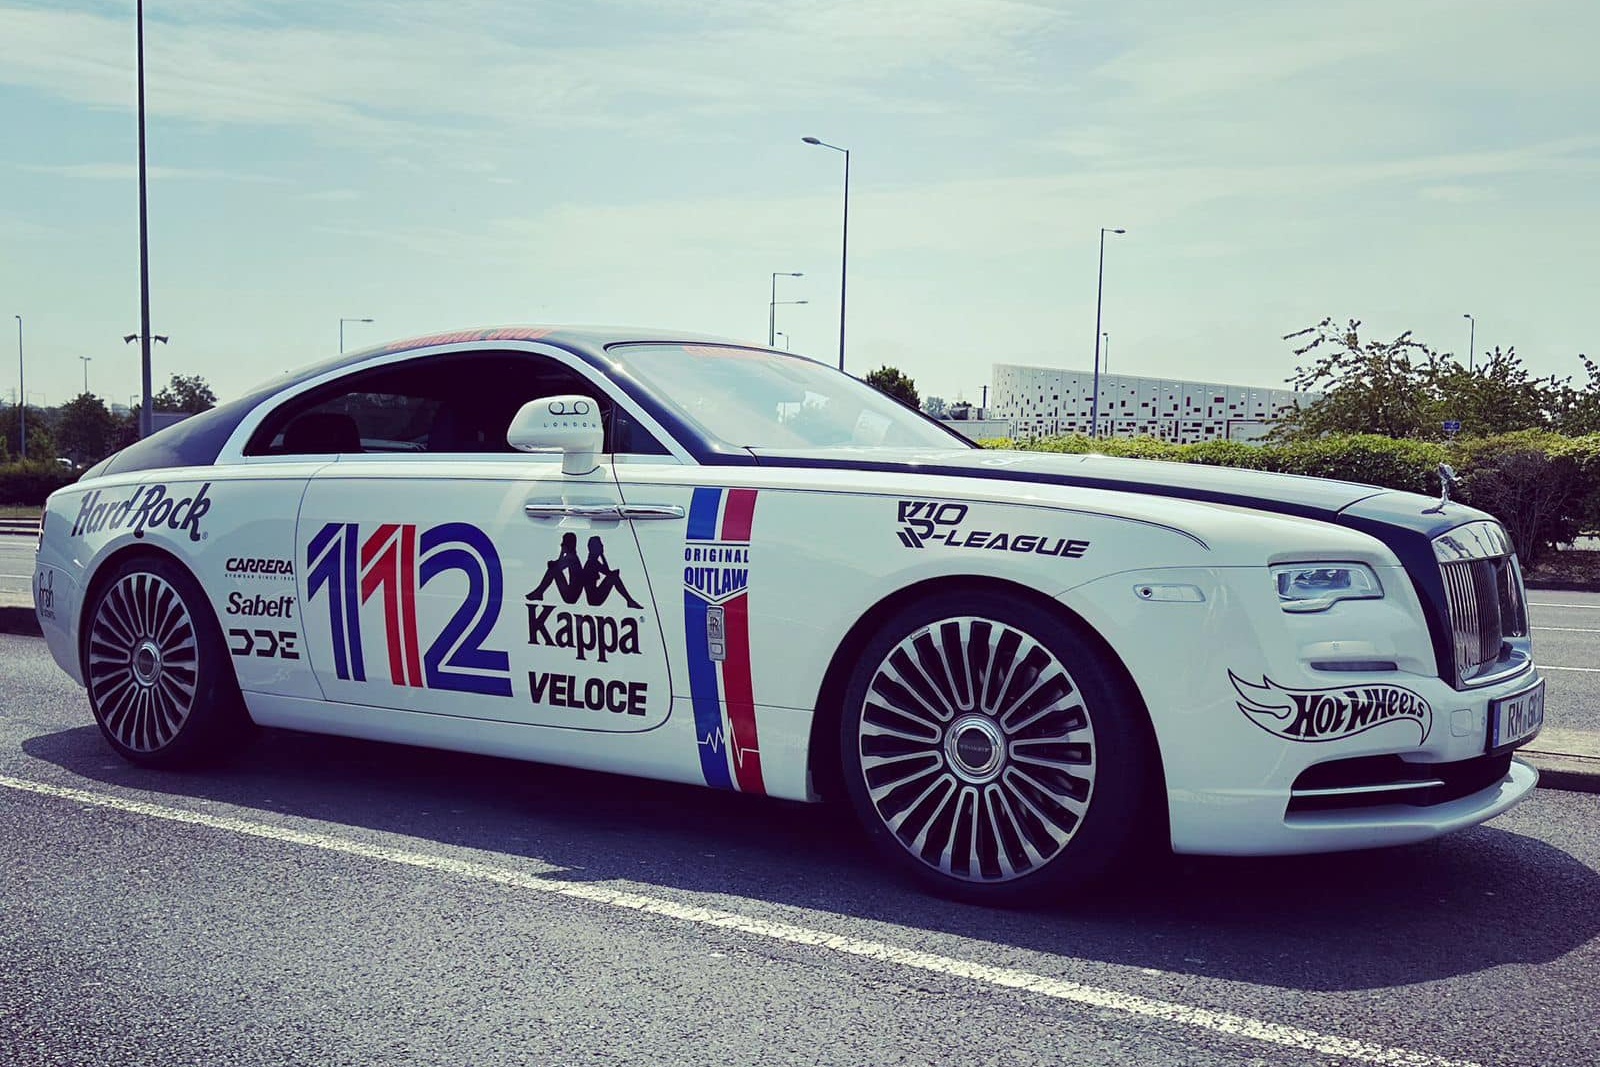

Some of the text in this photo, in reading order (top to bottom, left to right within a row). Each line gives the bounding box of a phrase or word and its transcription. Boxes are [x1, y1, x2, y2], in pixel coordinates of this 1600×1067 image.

[71, 482, 211, 542] Hard Rock
[226, 558, 293, 575] CARRERA
[684, 547, 749, 563] ORIGINAL
[684, 566, 749, 596] OUTLAW
[226, 591, 293, 618] Sabelt
[307, 522, 514, 697] 112
[525, 604, 642, 663] Kappa
[528, 671, 648, 716] VELOCE
[1507, 700, 1524, 738] RM
